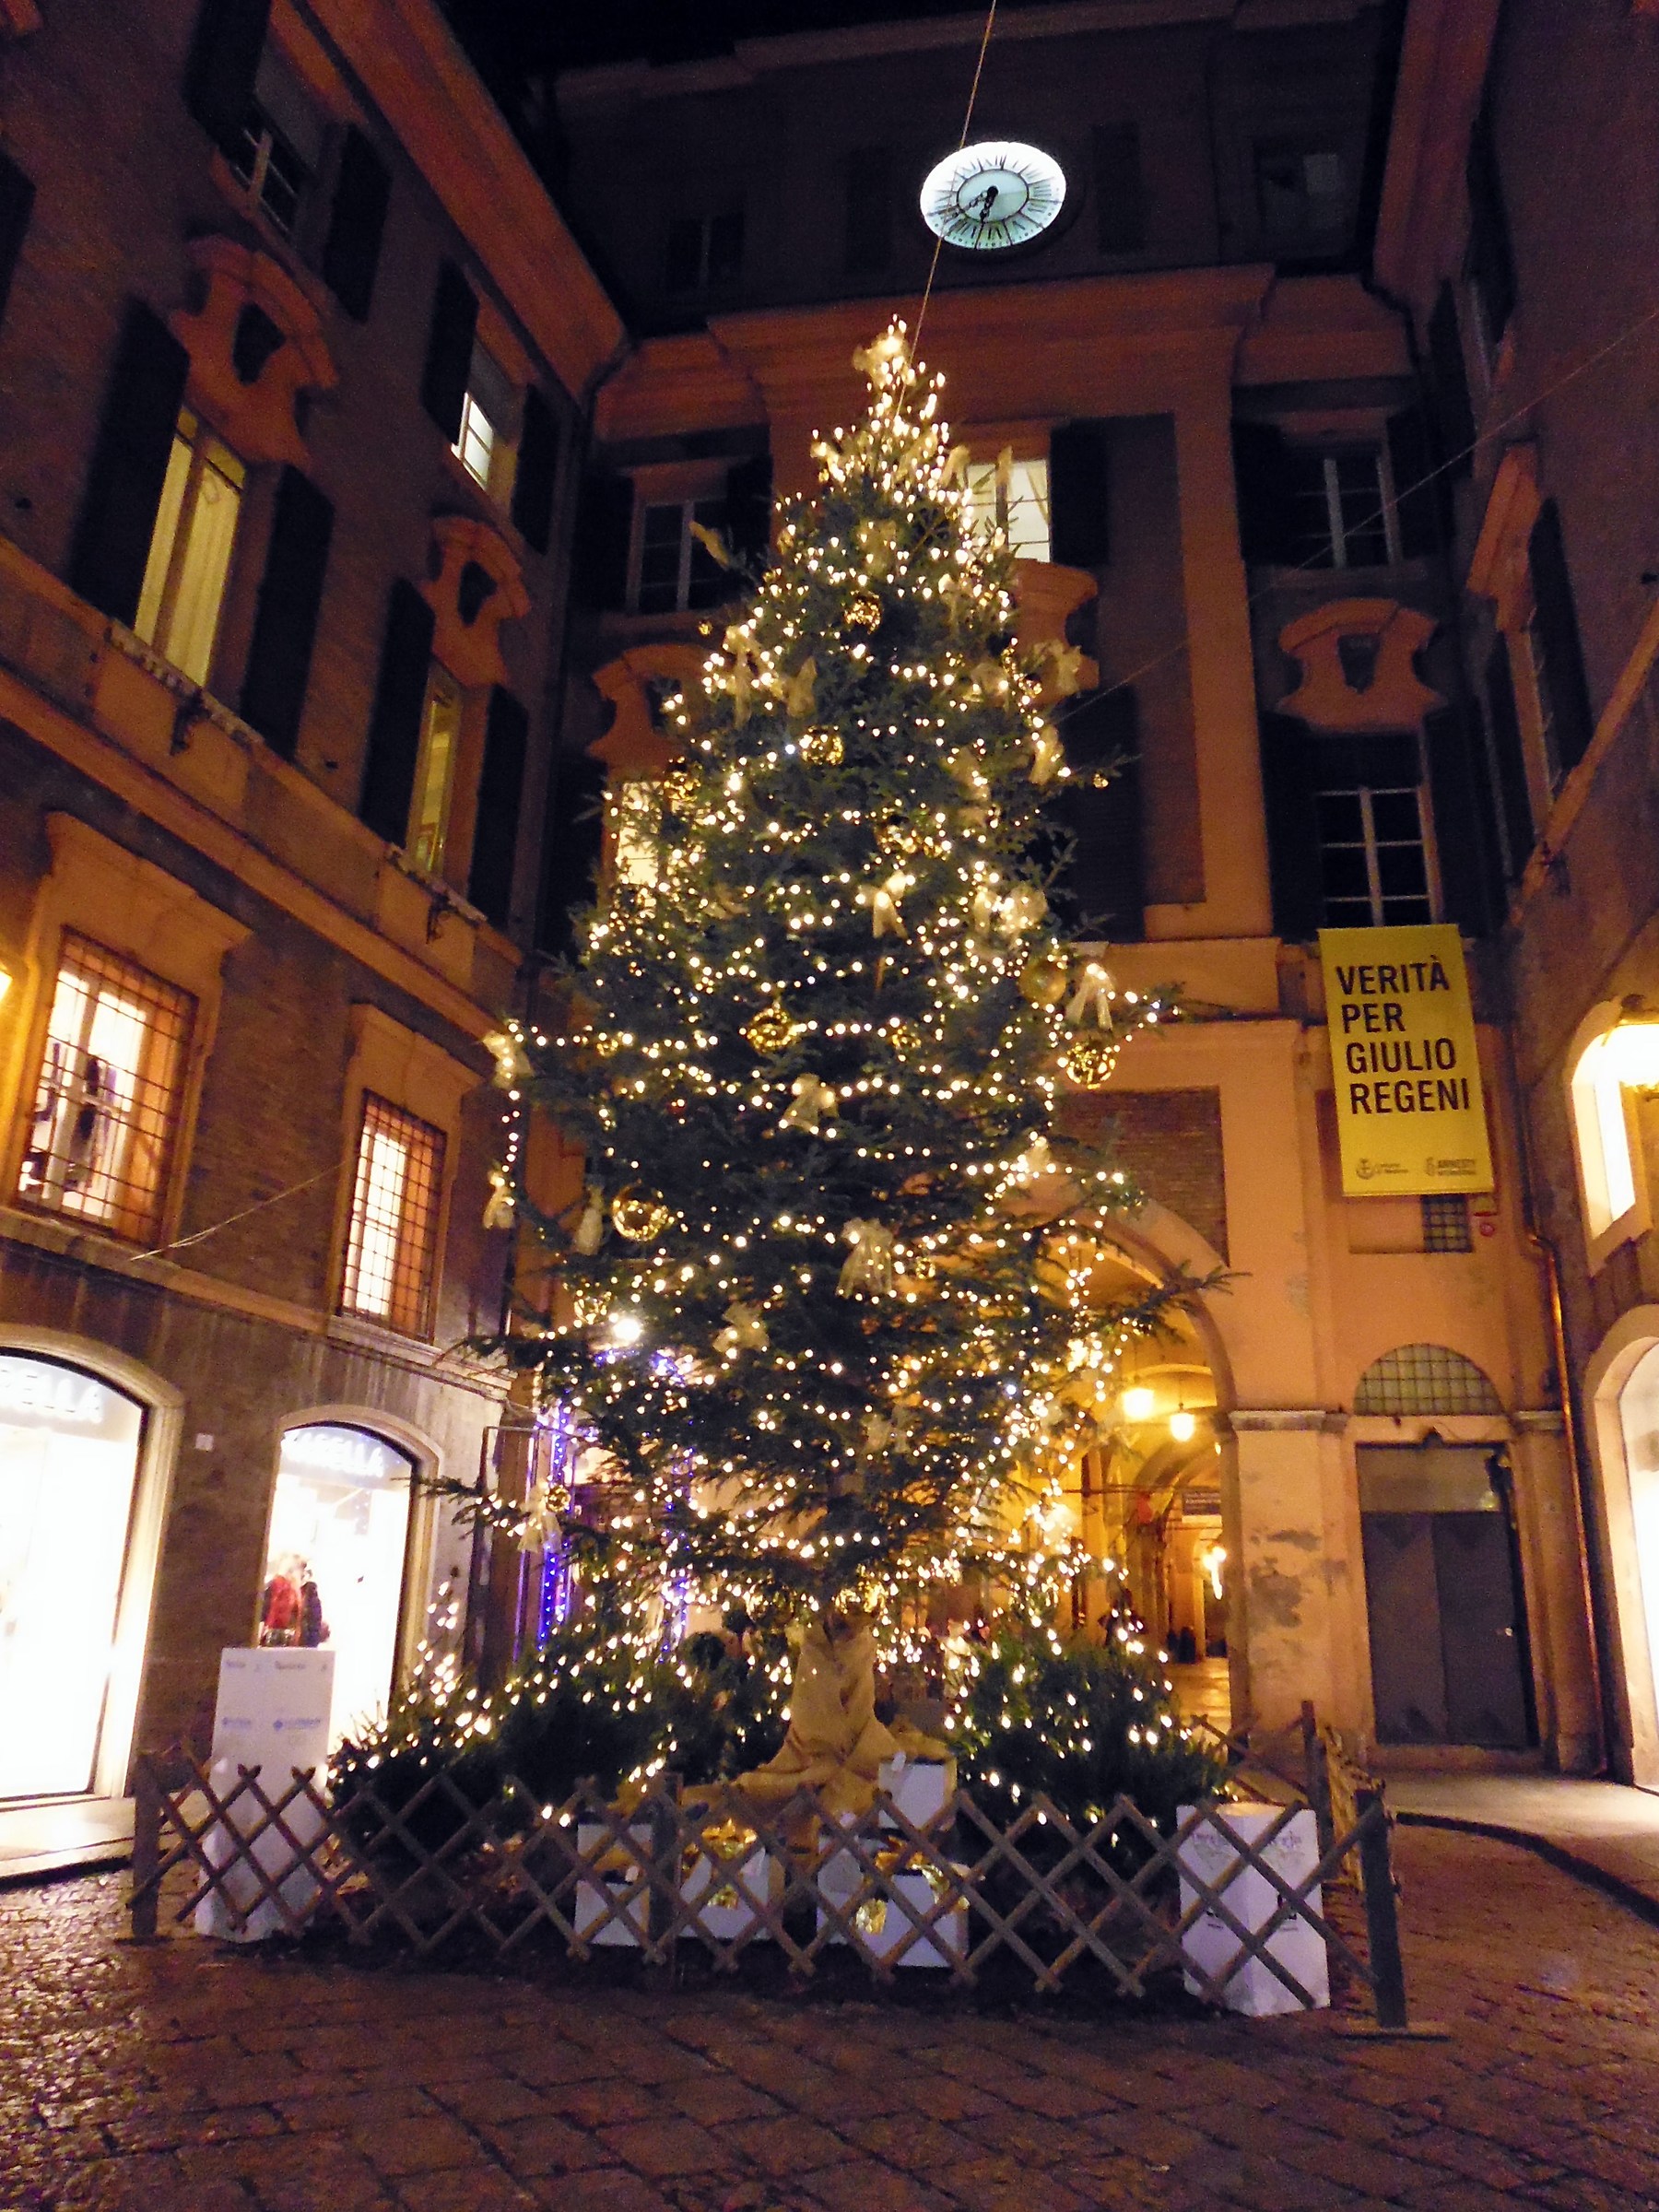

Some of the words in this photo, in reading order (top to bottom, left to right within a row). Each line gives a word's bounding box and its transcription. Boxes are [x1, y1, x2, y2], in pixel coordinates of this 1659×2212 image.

[1336, 955, 1450, 995] VERITÀ
[1342, 1002, 1406, 1034] PER
[1346, 1037, 1457, 1074] GIULIO
[1350, 1077, 1471, 1114] REGENI
